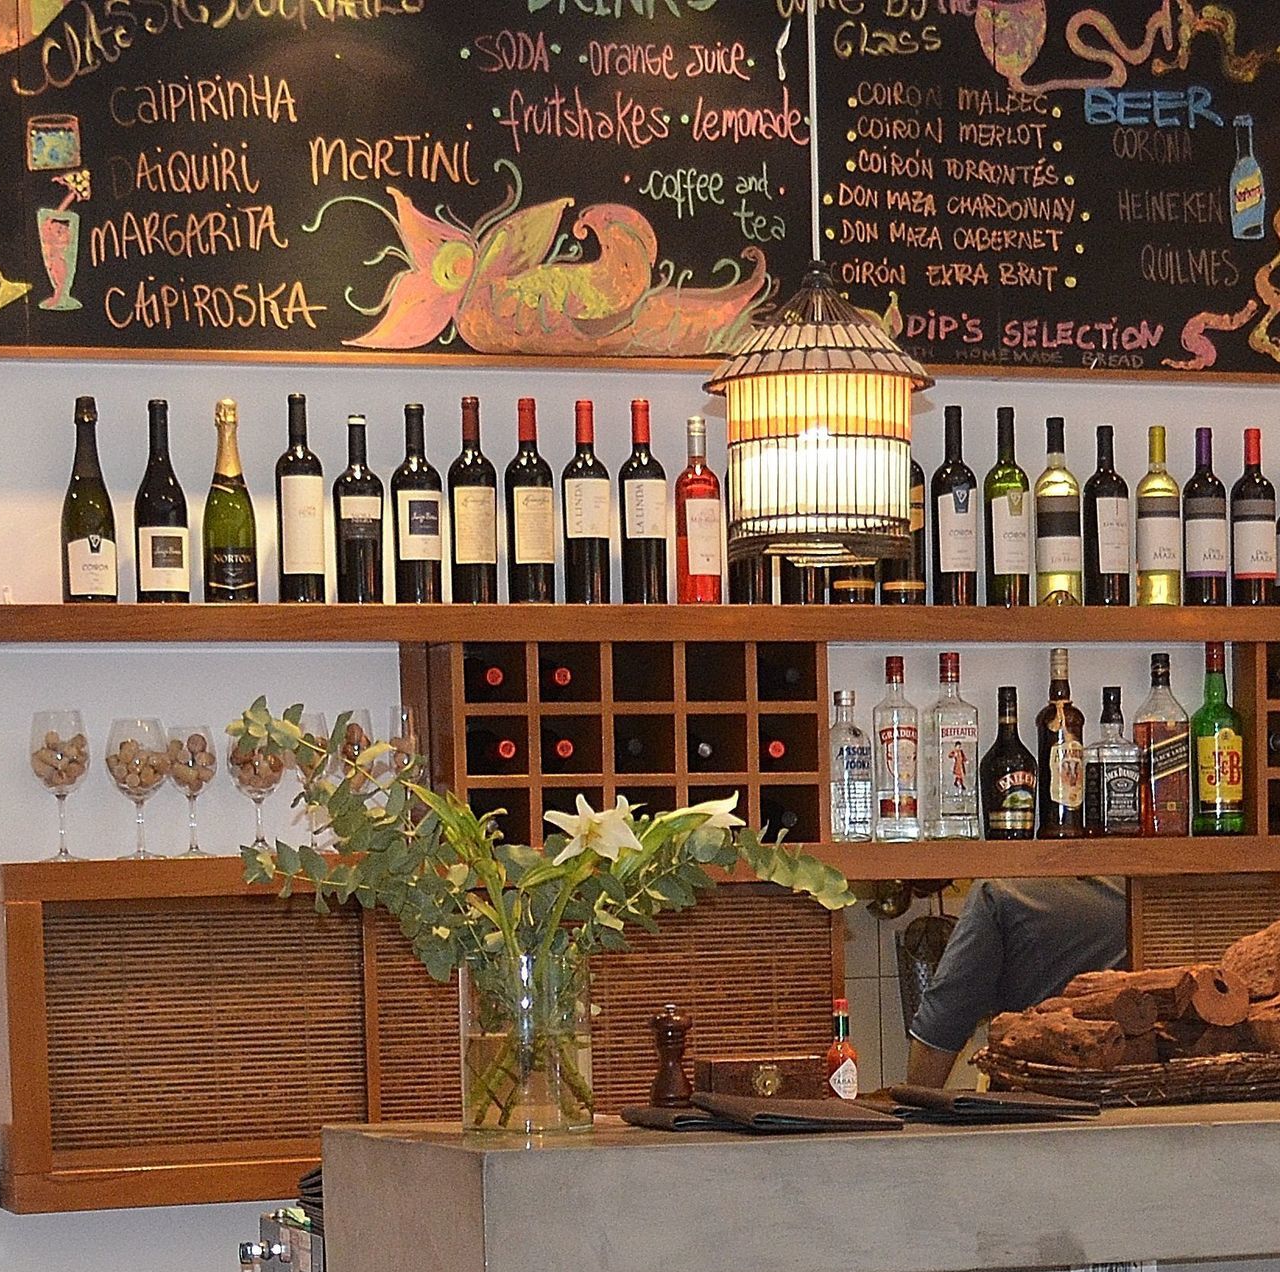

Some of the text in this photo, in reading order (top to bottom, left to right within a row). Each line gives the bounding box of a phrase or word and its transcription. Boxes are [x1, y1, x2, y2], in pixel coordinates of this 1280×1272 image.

[474, 31, 550, 73] SODA
[1084, 86, 1223, 129] BEER
[1112, 127, 1193, 164] CORONA
[639, 162, 773, 219] coffee and
[838, 183, 878, 208] DON
[946, 197, 1076, 224] CHARDONNAY
[732, 199, 787, 241] tea
[840, 218, 878, 246] DON
[953, 227, 1064, 252] CABERNET
[999, 262, 1059, 292] BRUT
[941, 727, 977, 738] BEEFEATER
